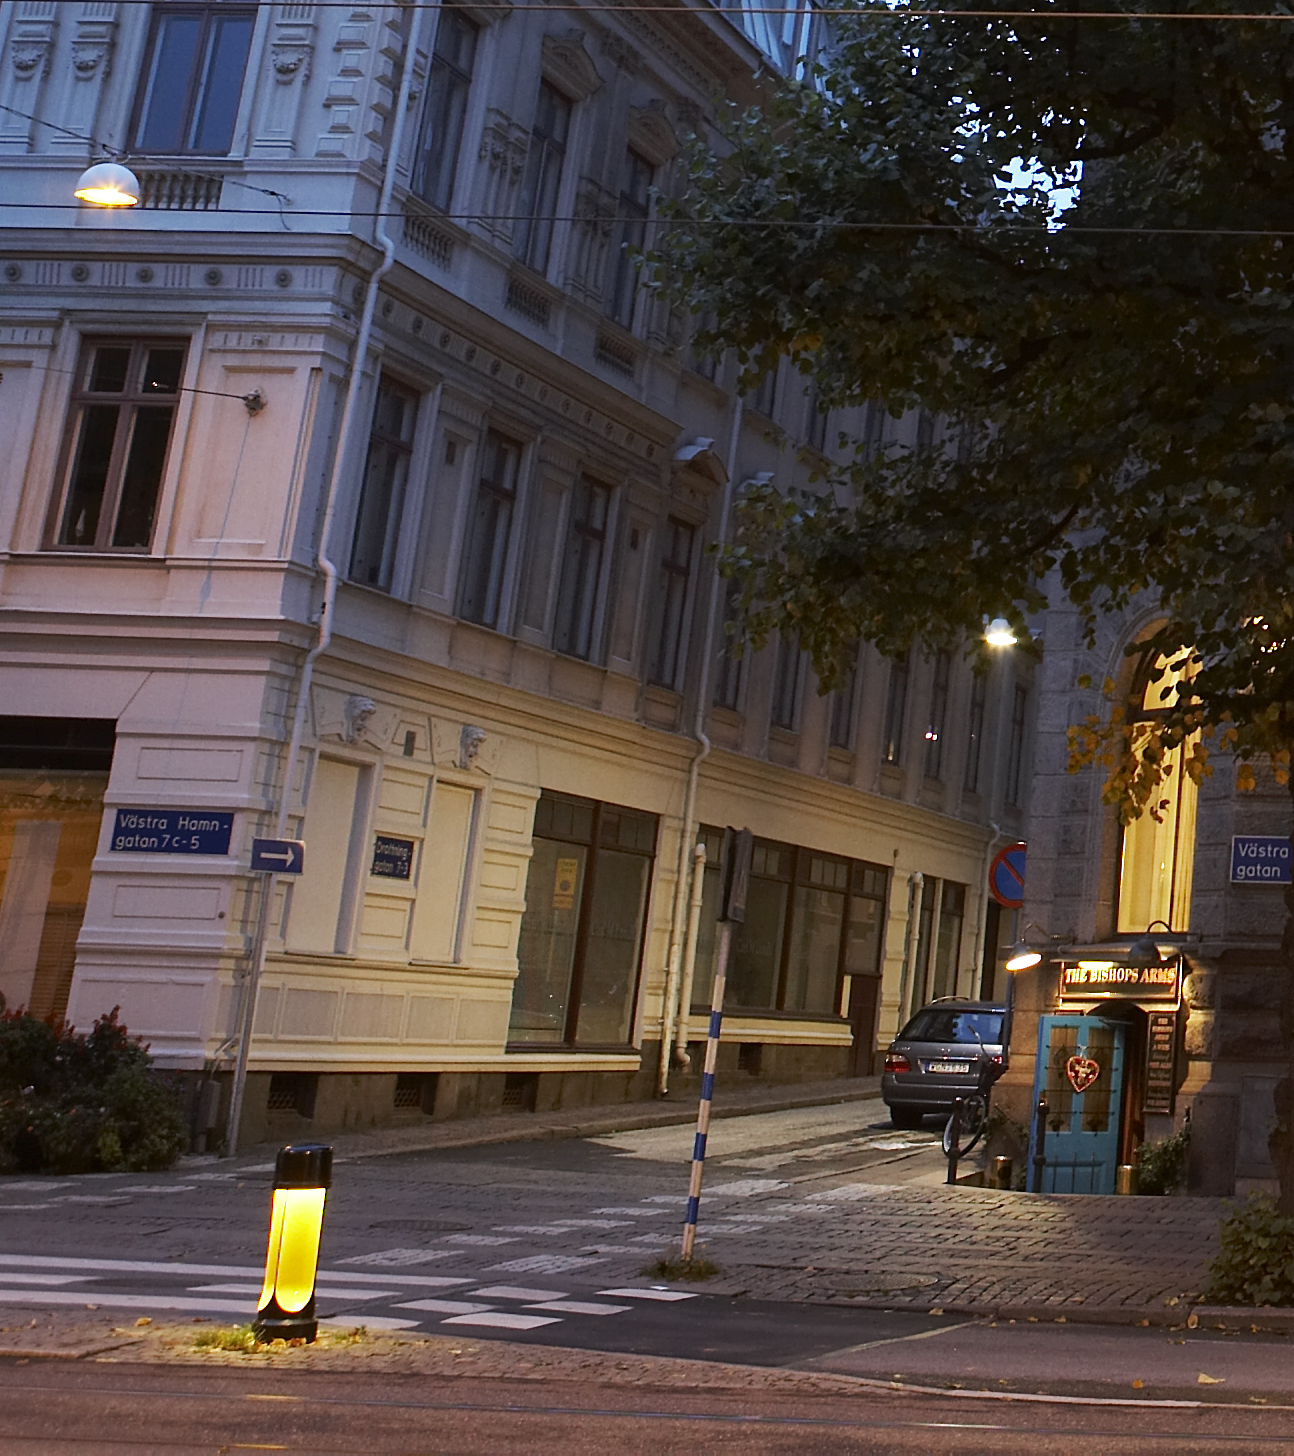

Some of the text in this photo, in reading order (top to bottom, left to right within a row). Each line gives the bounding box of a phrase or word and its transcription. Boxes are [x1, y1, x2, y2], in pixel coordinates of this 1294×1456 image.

[120, 814, 167, 830] Västra
[115, 834, 158, 850] gatan
[1238, 842, 1289, 859] Västra
[1236, 863, 1281, 879] gatan
[1065, 967, 1176, 984] THE BISHOPS ARMS
